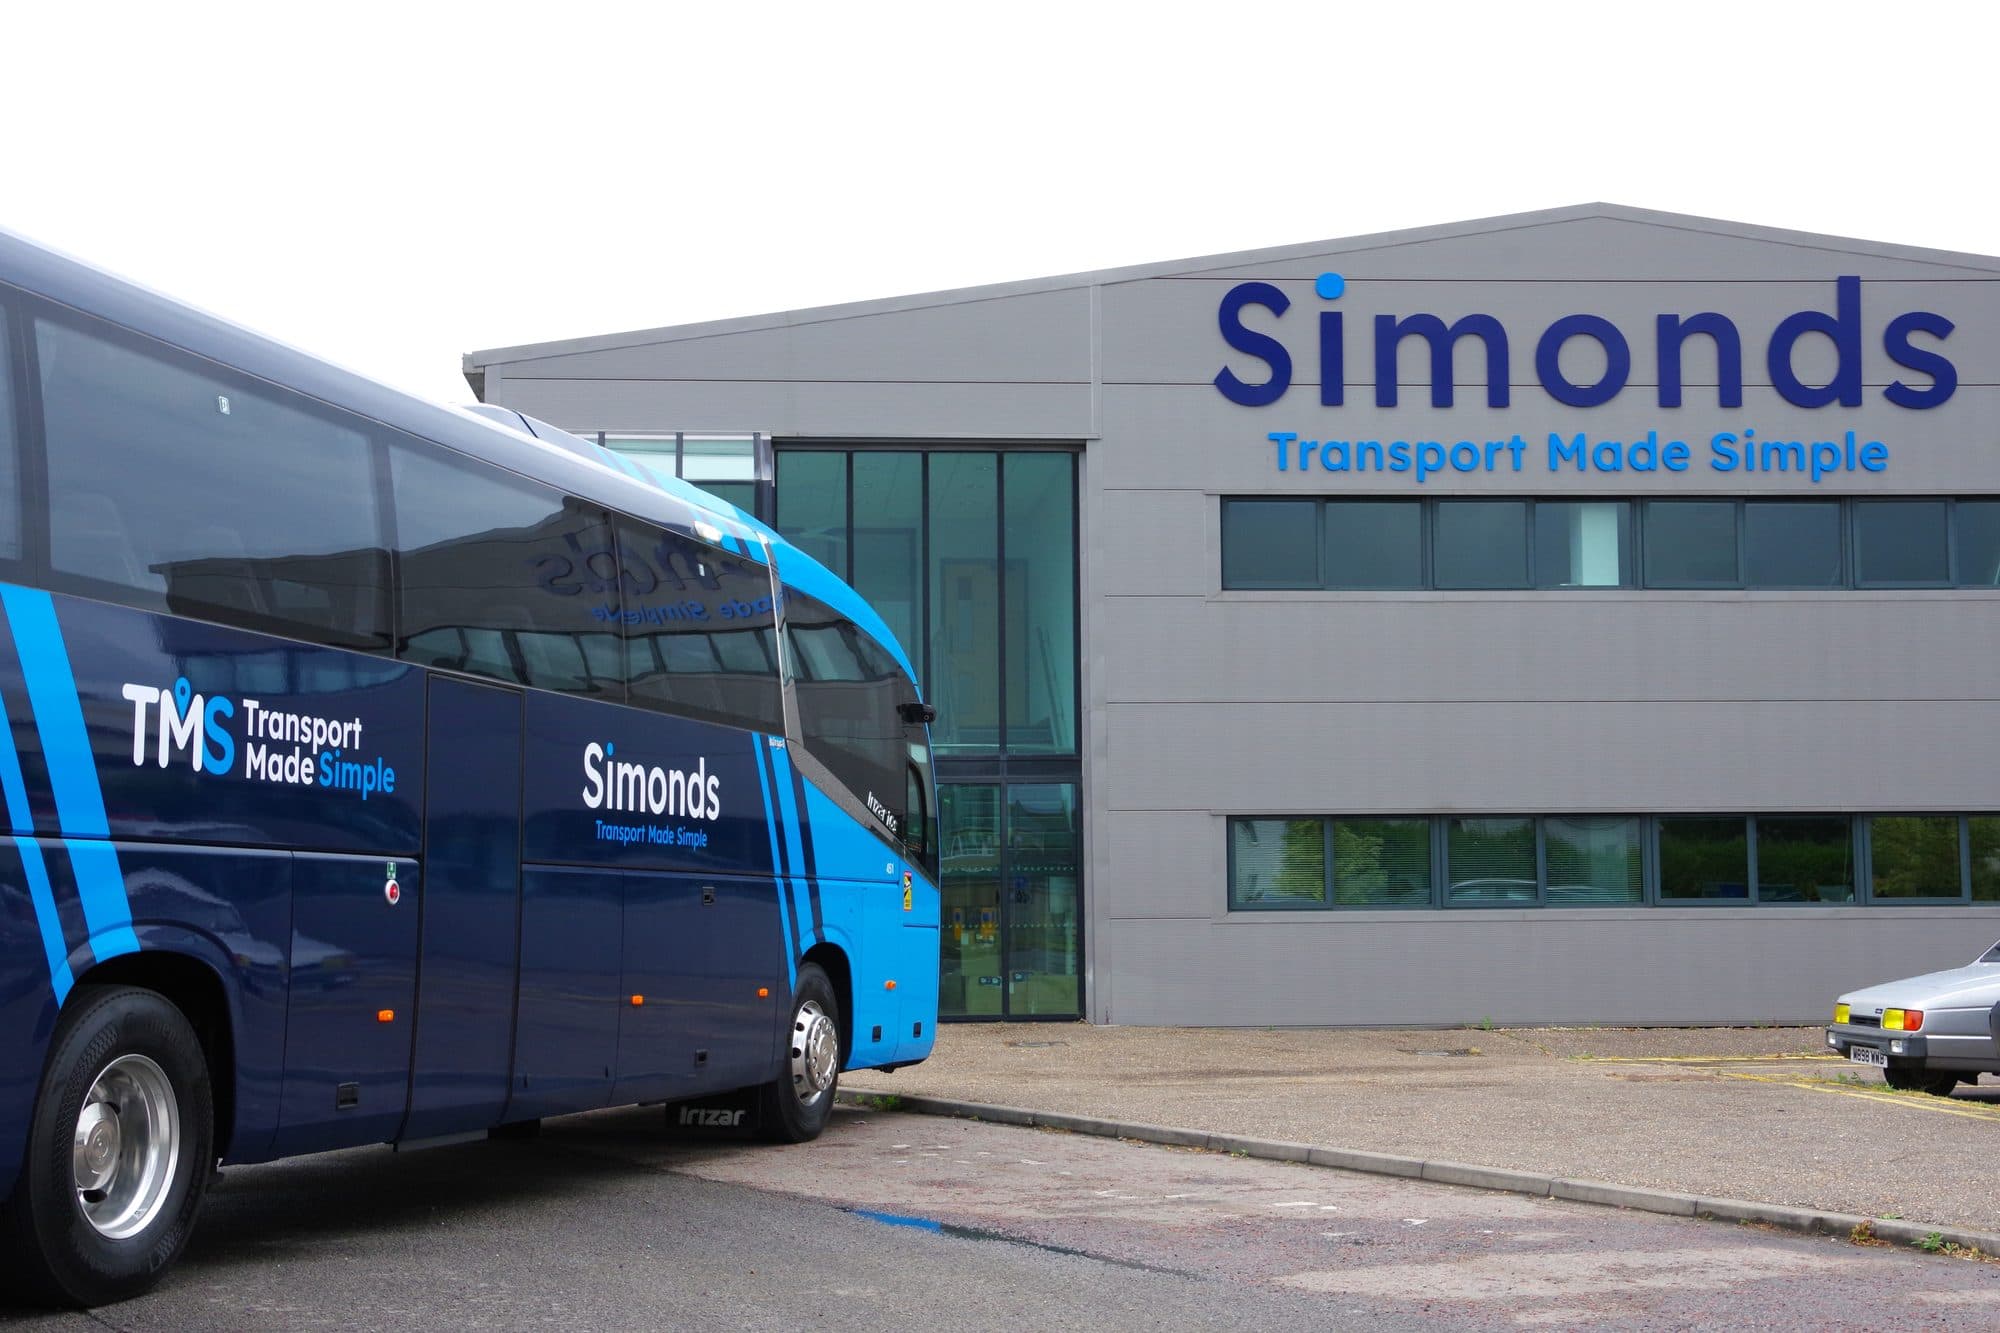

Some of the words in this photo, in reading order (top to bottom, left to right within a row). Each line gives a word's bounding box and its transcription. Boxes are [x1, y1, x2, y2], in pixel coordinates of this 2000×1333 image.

[1213, 272, 1957, 410] Simonds
[1268, 432, 1526, 482] Transport
[1549, 430, 1690, 473] Made
[1711, 429, 1889, 483] Simple
[122, 677, 235, 775] TMS
[243, 698, 362, 754] Transport
[245, 742, 314, 785] Made
[318, 750, 395, 800] Simple
[582, 742, 720, 821] Simonds
[596, 820, 646, 847] Transport
[648, 825, 675, 845] Made
[677, 826, 708, 850] Simple
